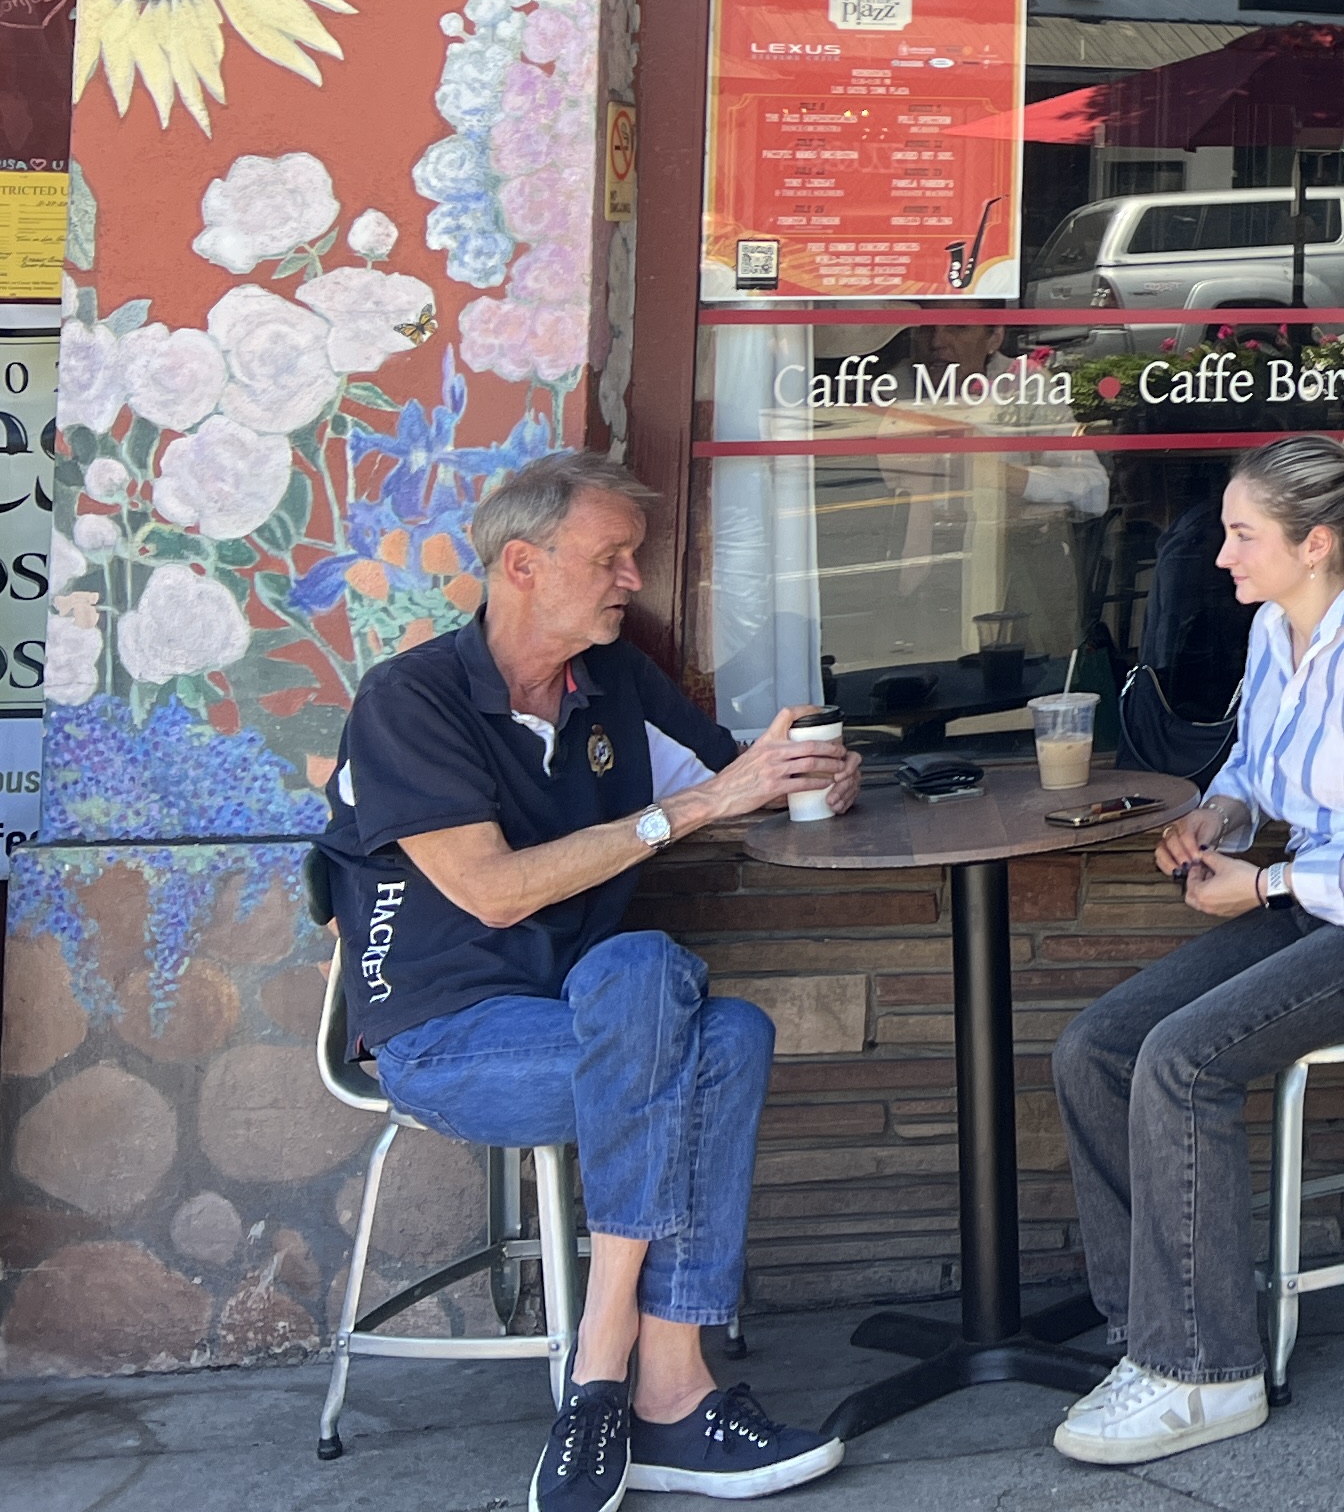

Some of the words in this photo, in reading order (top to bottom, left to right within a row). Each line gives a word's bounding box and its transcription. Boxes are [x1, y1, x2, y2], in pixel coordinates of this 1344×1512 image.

[751, 43, 841, 55] LEXUS
[772, 356, 898, 409] Caffe
[911, 356, 1075, 407] Mocha
[1139, 353, 1255, 405] Caffe
[361, 880, 406, 1004] HACKETT
